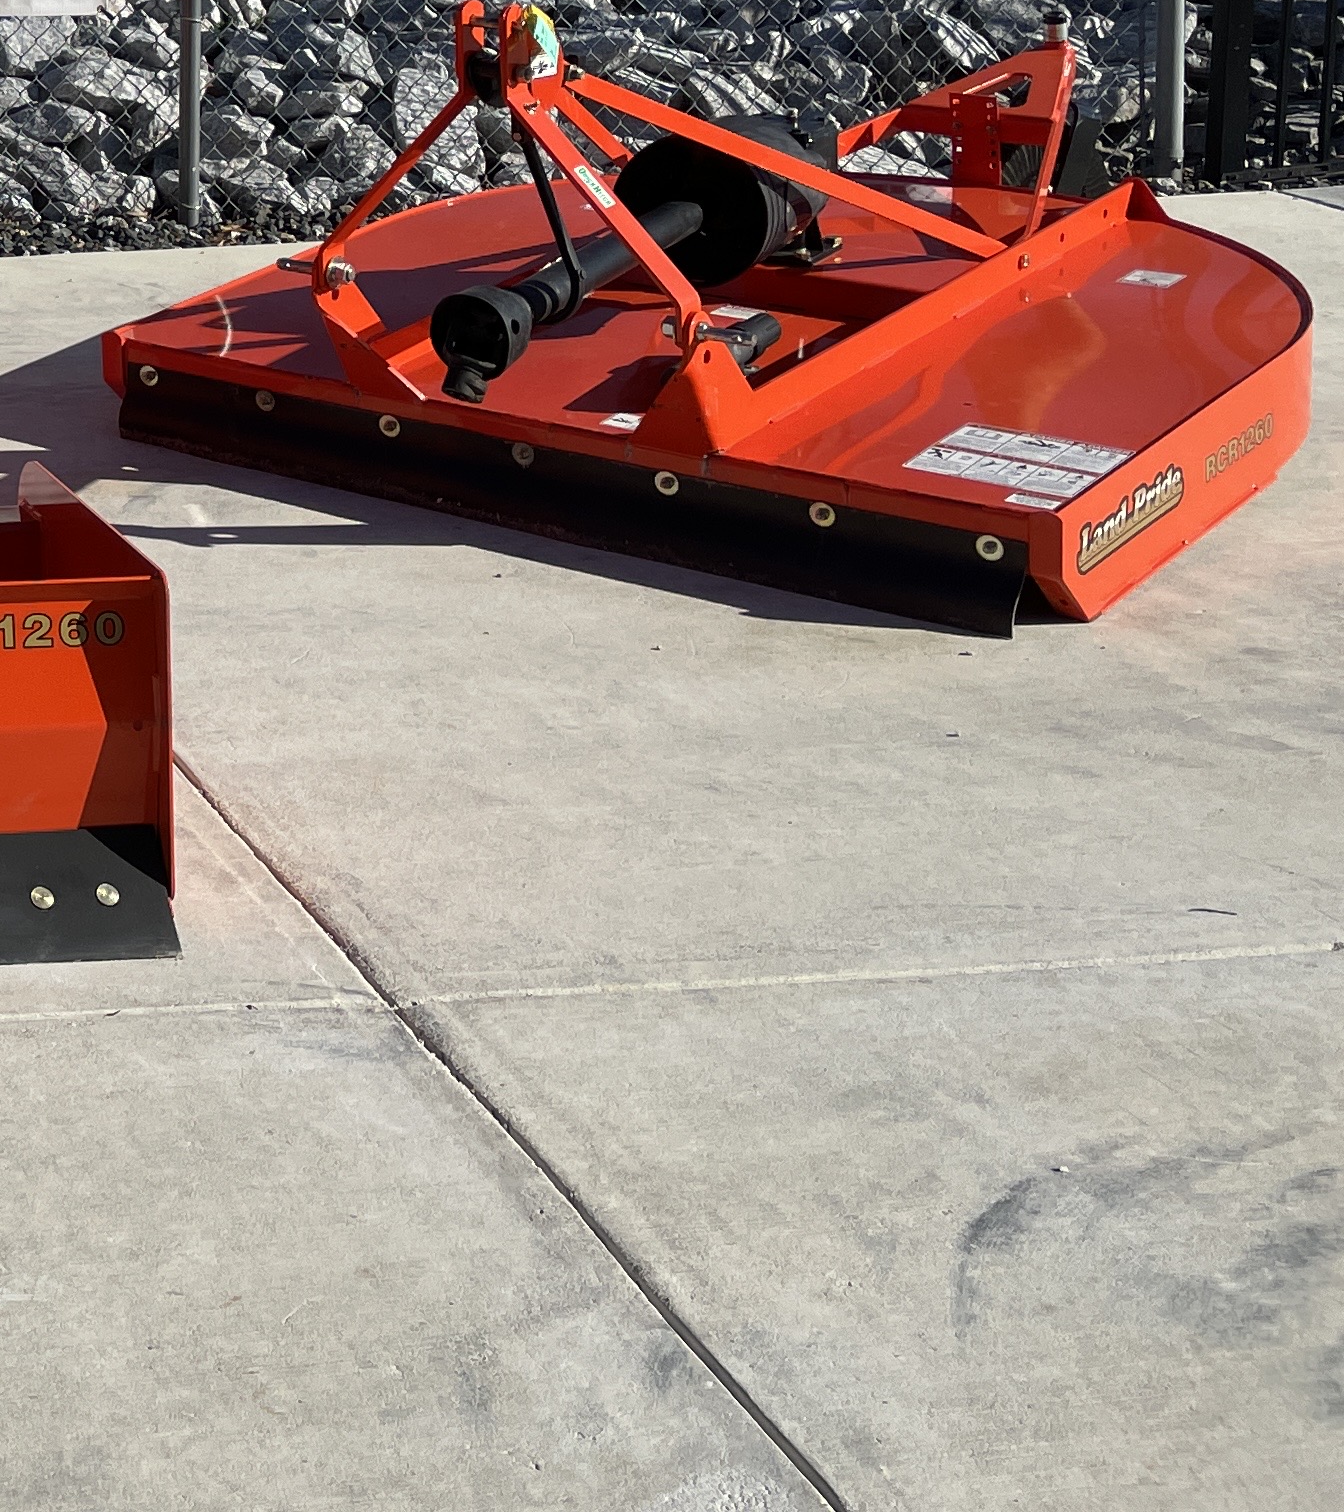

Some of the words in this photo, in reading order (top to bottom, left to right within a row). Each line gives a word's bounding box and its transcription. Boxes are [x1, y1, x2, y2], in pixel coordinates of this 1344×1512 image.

[1204, 413, 1274, 483] RCR1260
[1080, 495, 1129, 564] Land
[1133, 463, 1182, 525] Pride
